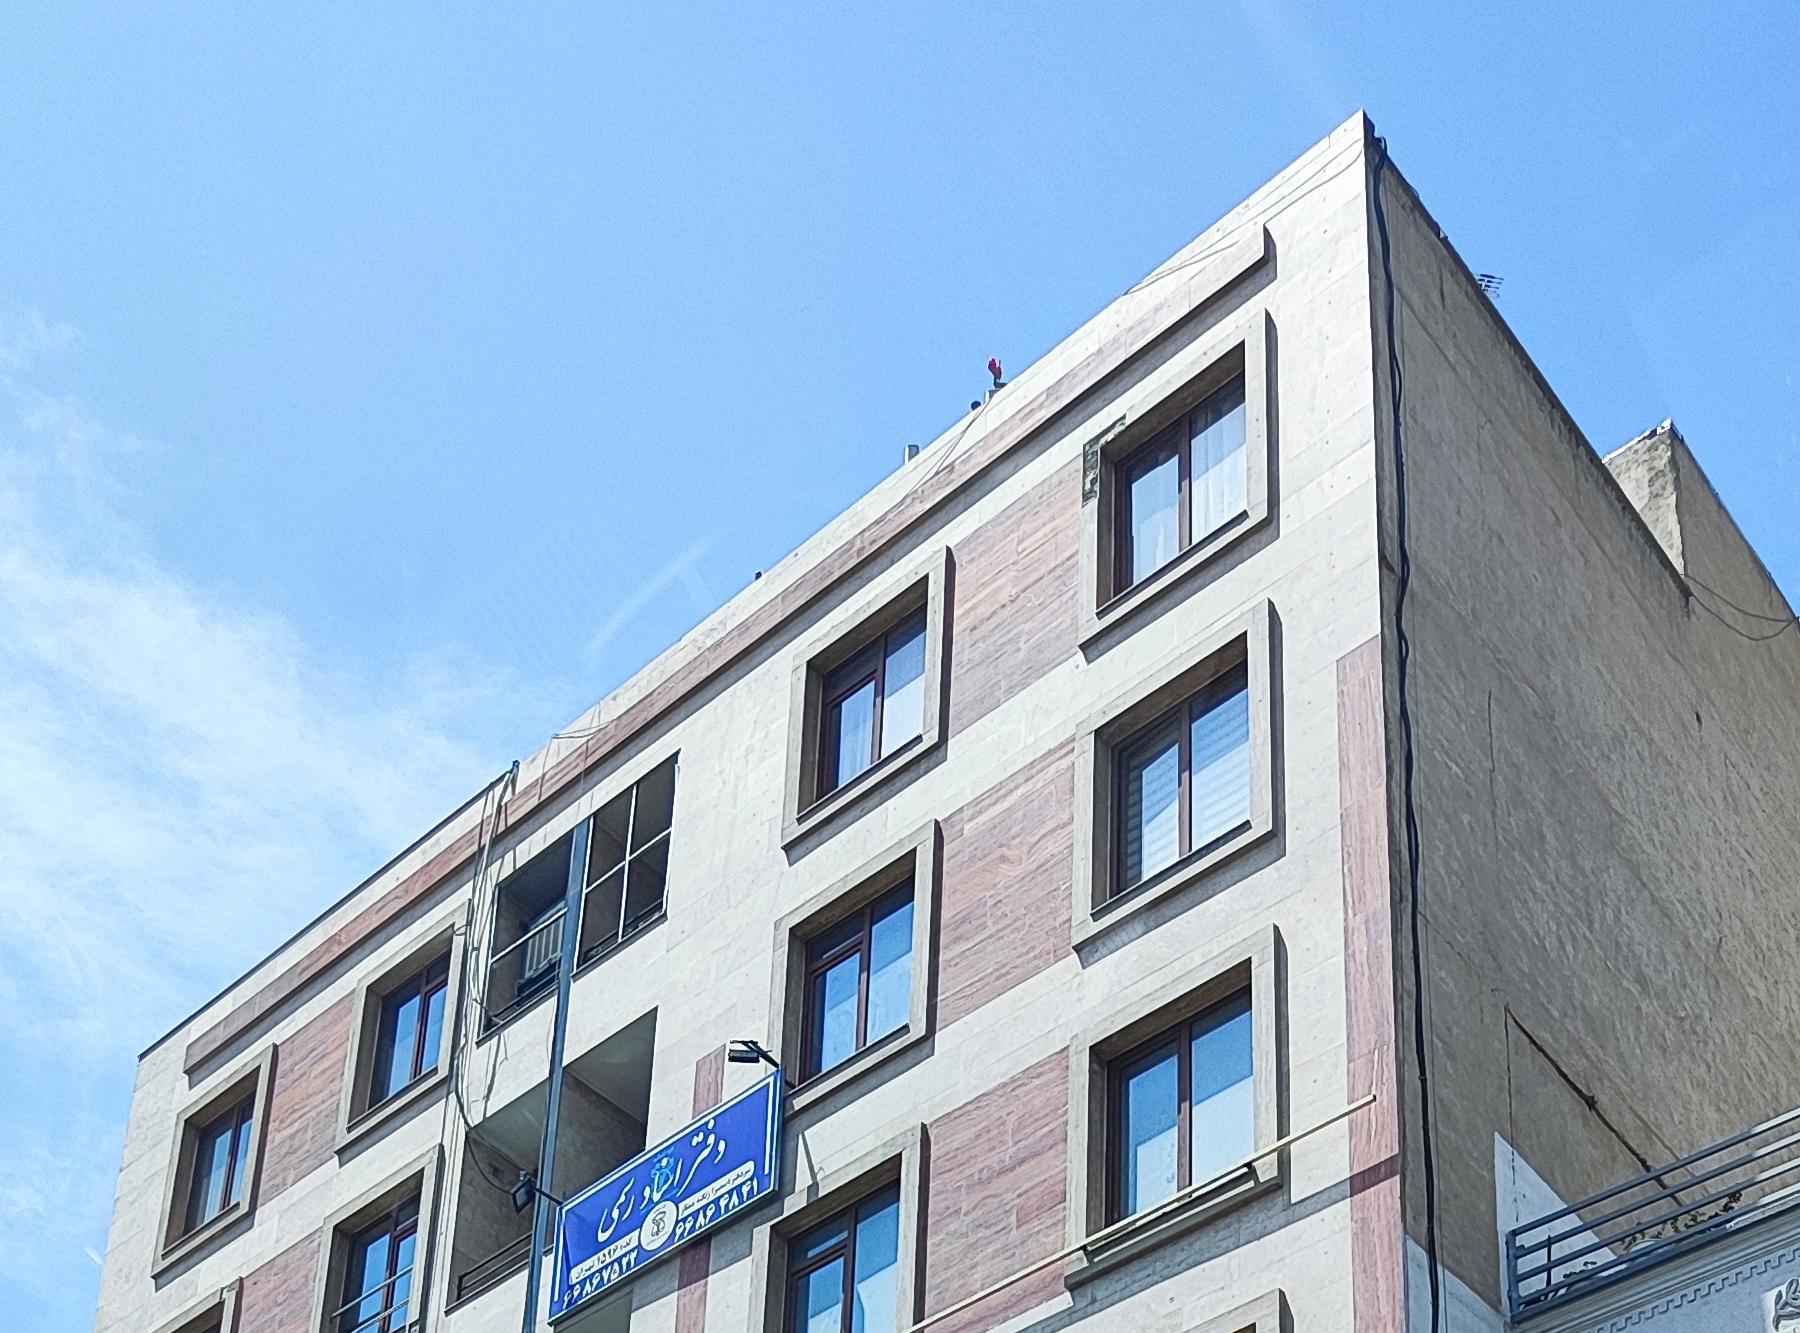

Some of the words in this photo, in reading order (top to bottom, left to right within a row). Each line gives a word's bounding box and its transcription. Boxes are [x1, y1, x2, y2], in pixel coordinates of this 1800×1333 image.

[640, 1157, 683, 1209] اسناد
[677, 1118, 726, 1197] دفتر
[598, 1177, 635, 1242] رسمی
